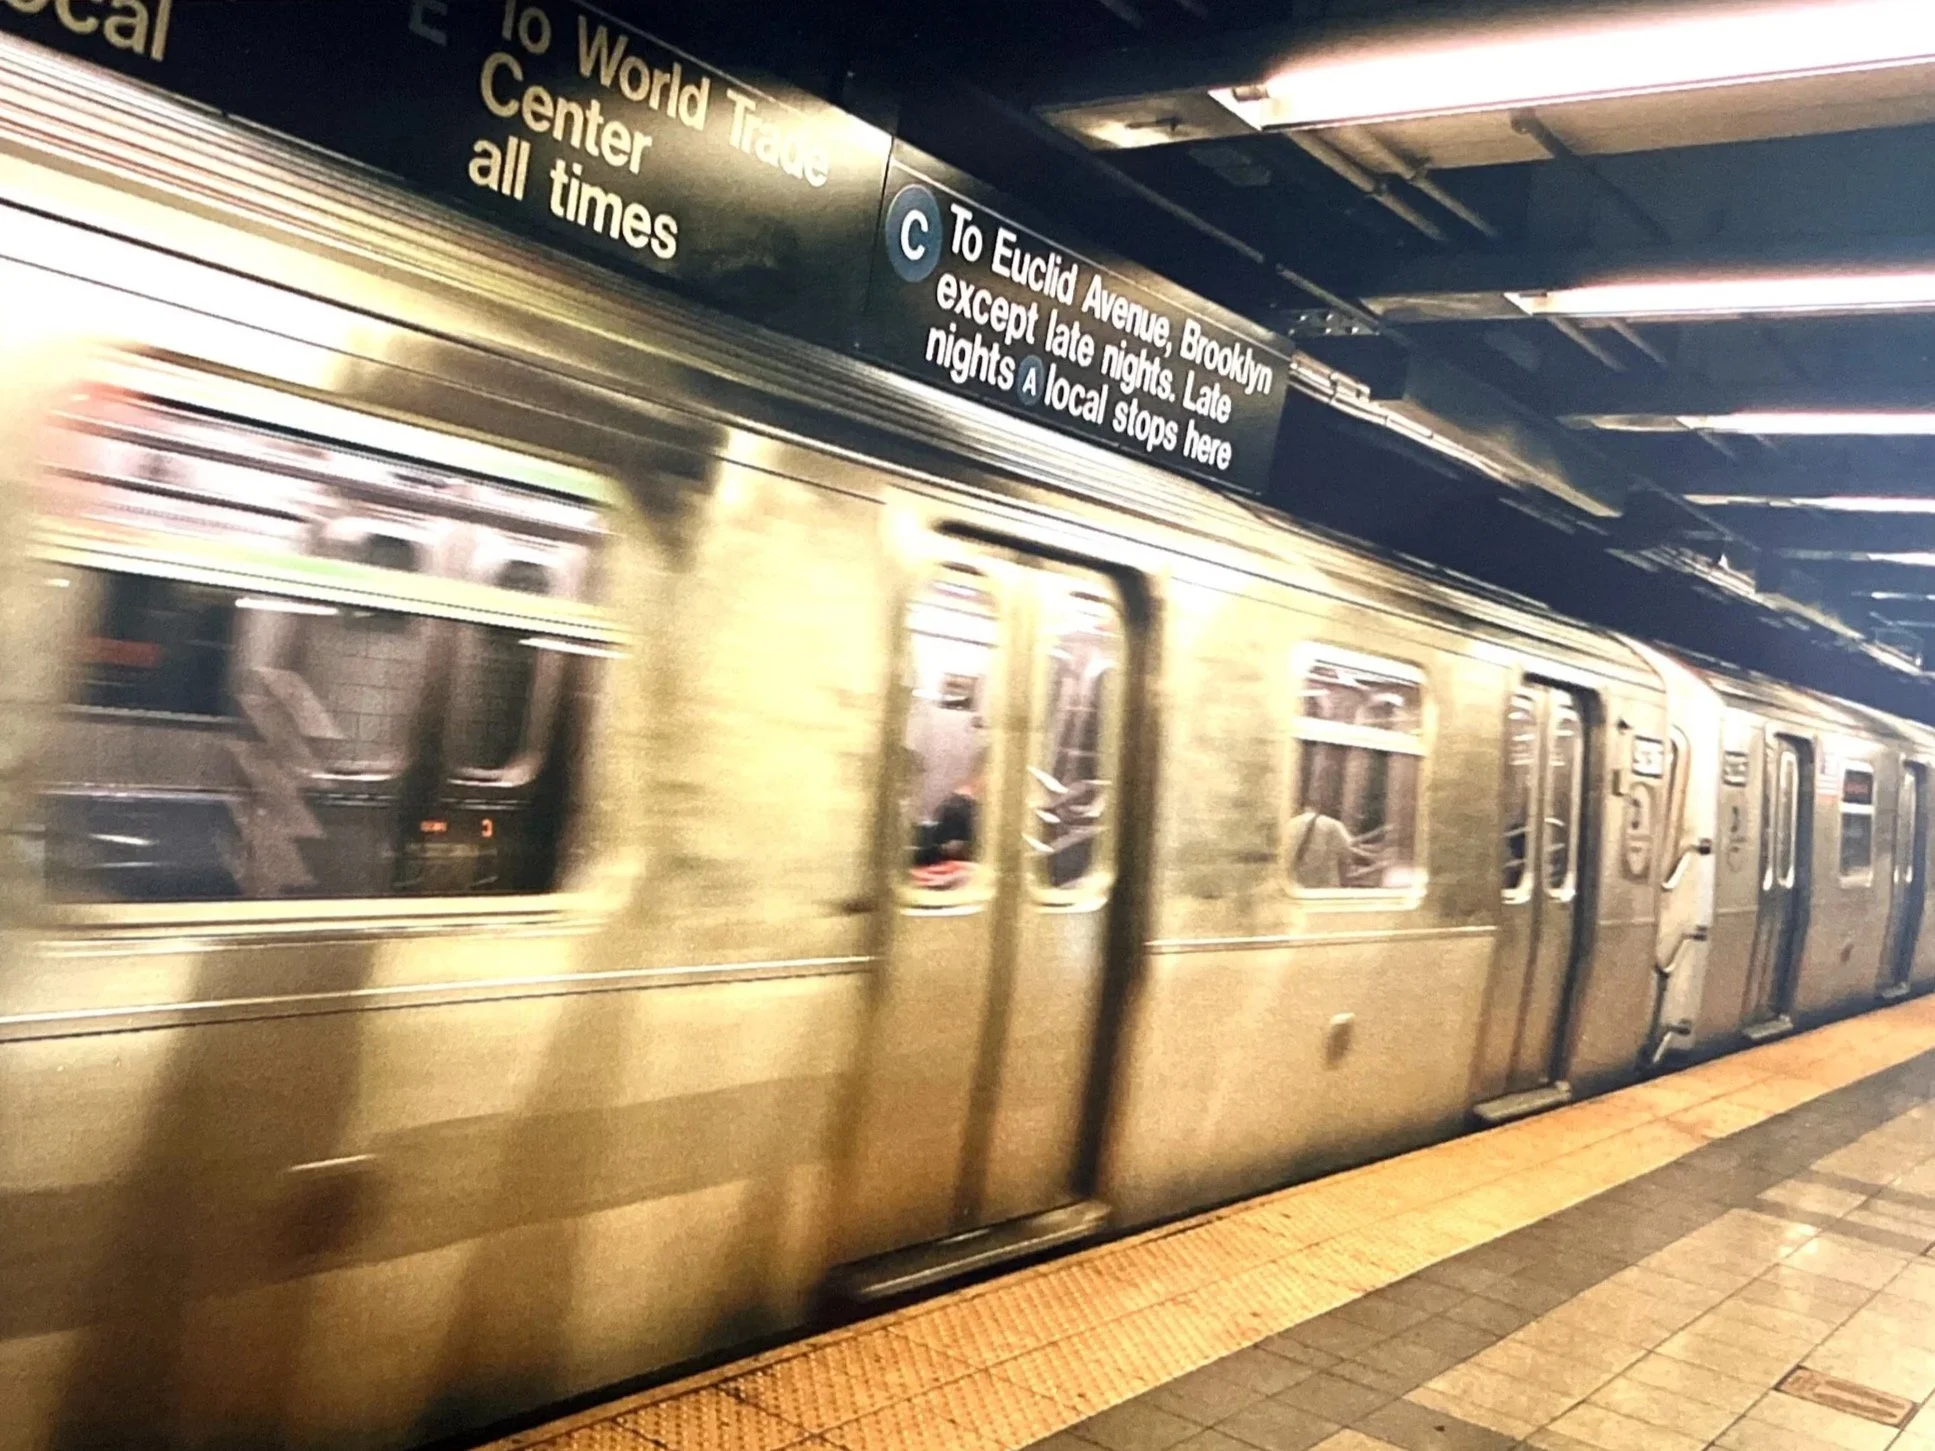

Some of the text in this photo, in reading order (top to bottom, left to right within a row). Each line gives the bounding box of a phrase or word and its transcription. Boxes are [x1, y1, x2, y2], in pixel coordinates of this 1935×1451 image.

[6, 0, 172, 62] cal
[480, 51, 652, 175] Center
[577, 14, 710, 131] World
[726, 88, 829, 187] Trade
[468, 136, 678, 260] all times
[900, 209, 929, 261] C
[936, 272, 1232, 423] except late nights. Late
[950, 203, 1273, 396] To Euclid Avenue, Brooklyn
[925, 322, 1232, 470] nights A local stops here
